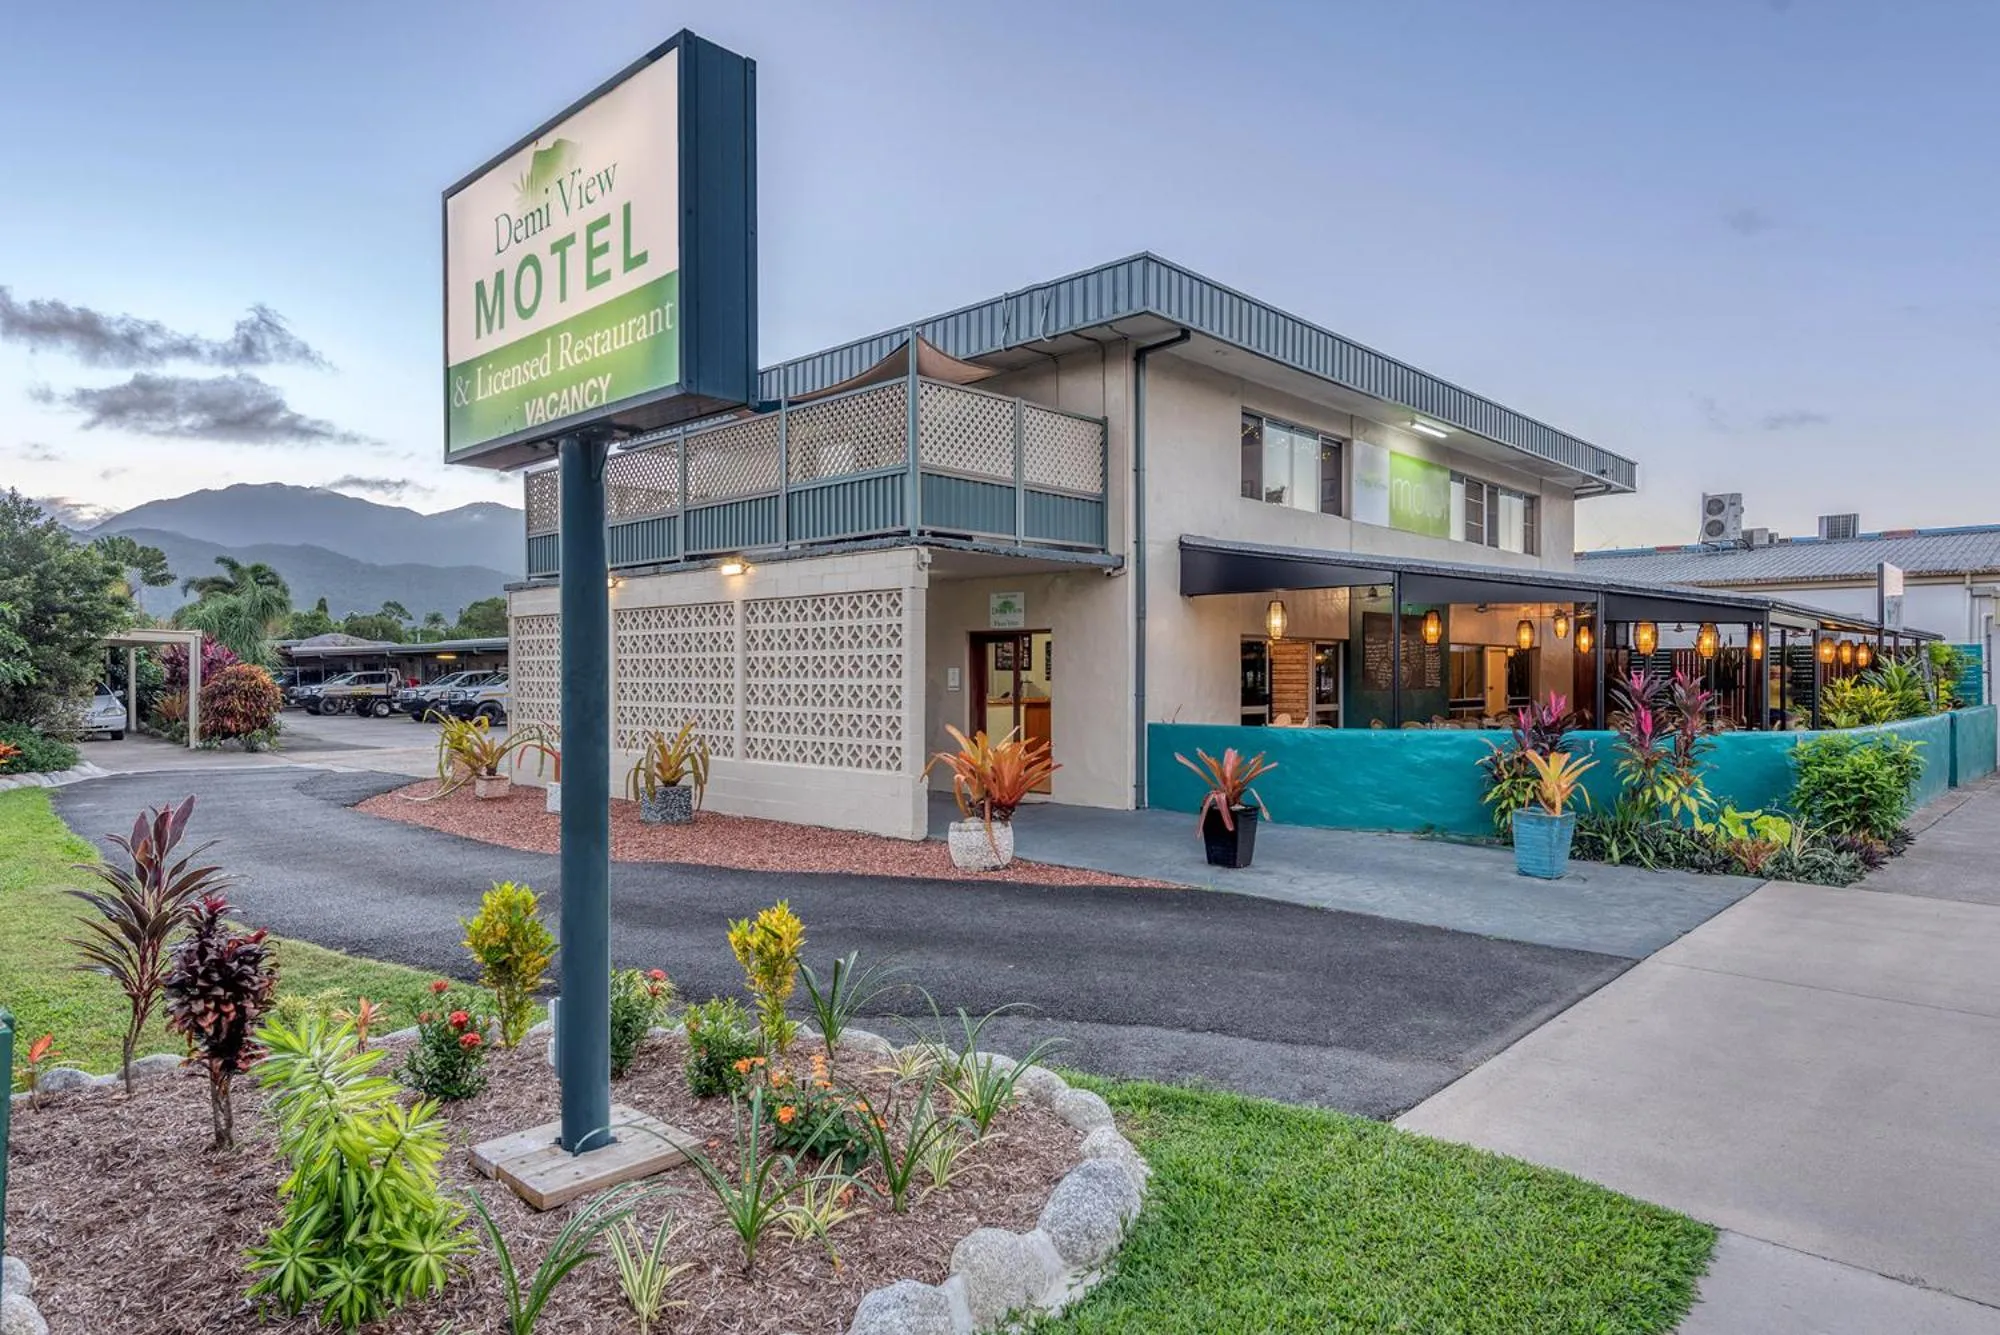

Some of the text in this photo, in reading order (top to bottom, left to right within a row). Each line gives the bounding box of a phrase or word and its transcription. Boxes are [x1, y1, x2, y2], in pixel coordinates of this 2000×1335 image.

[495, 163, 617, 256] Demi View
[475, 201, 649, 340] MOTEL
[453, 302, 674, 408] & Licensed Restaurant
[524, 373, 612, 427] VACANCY
